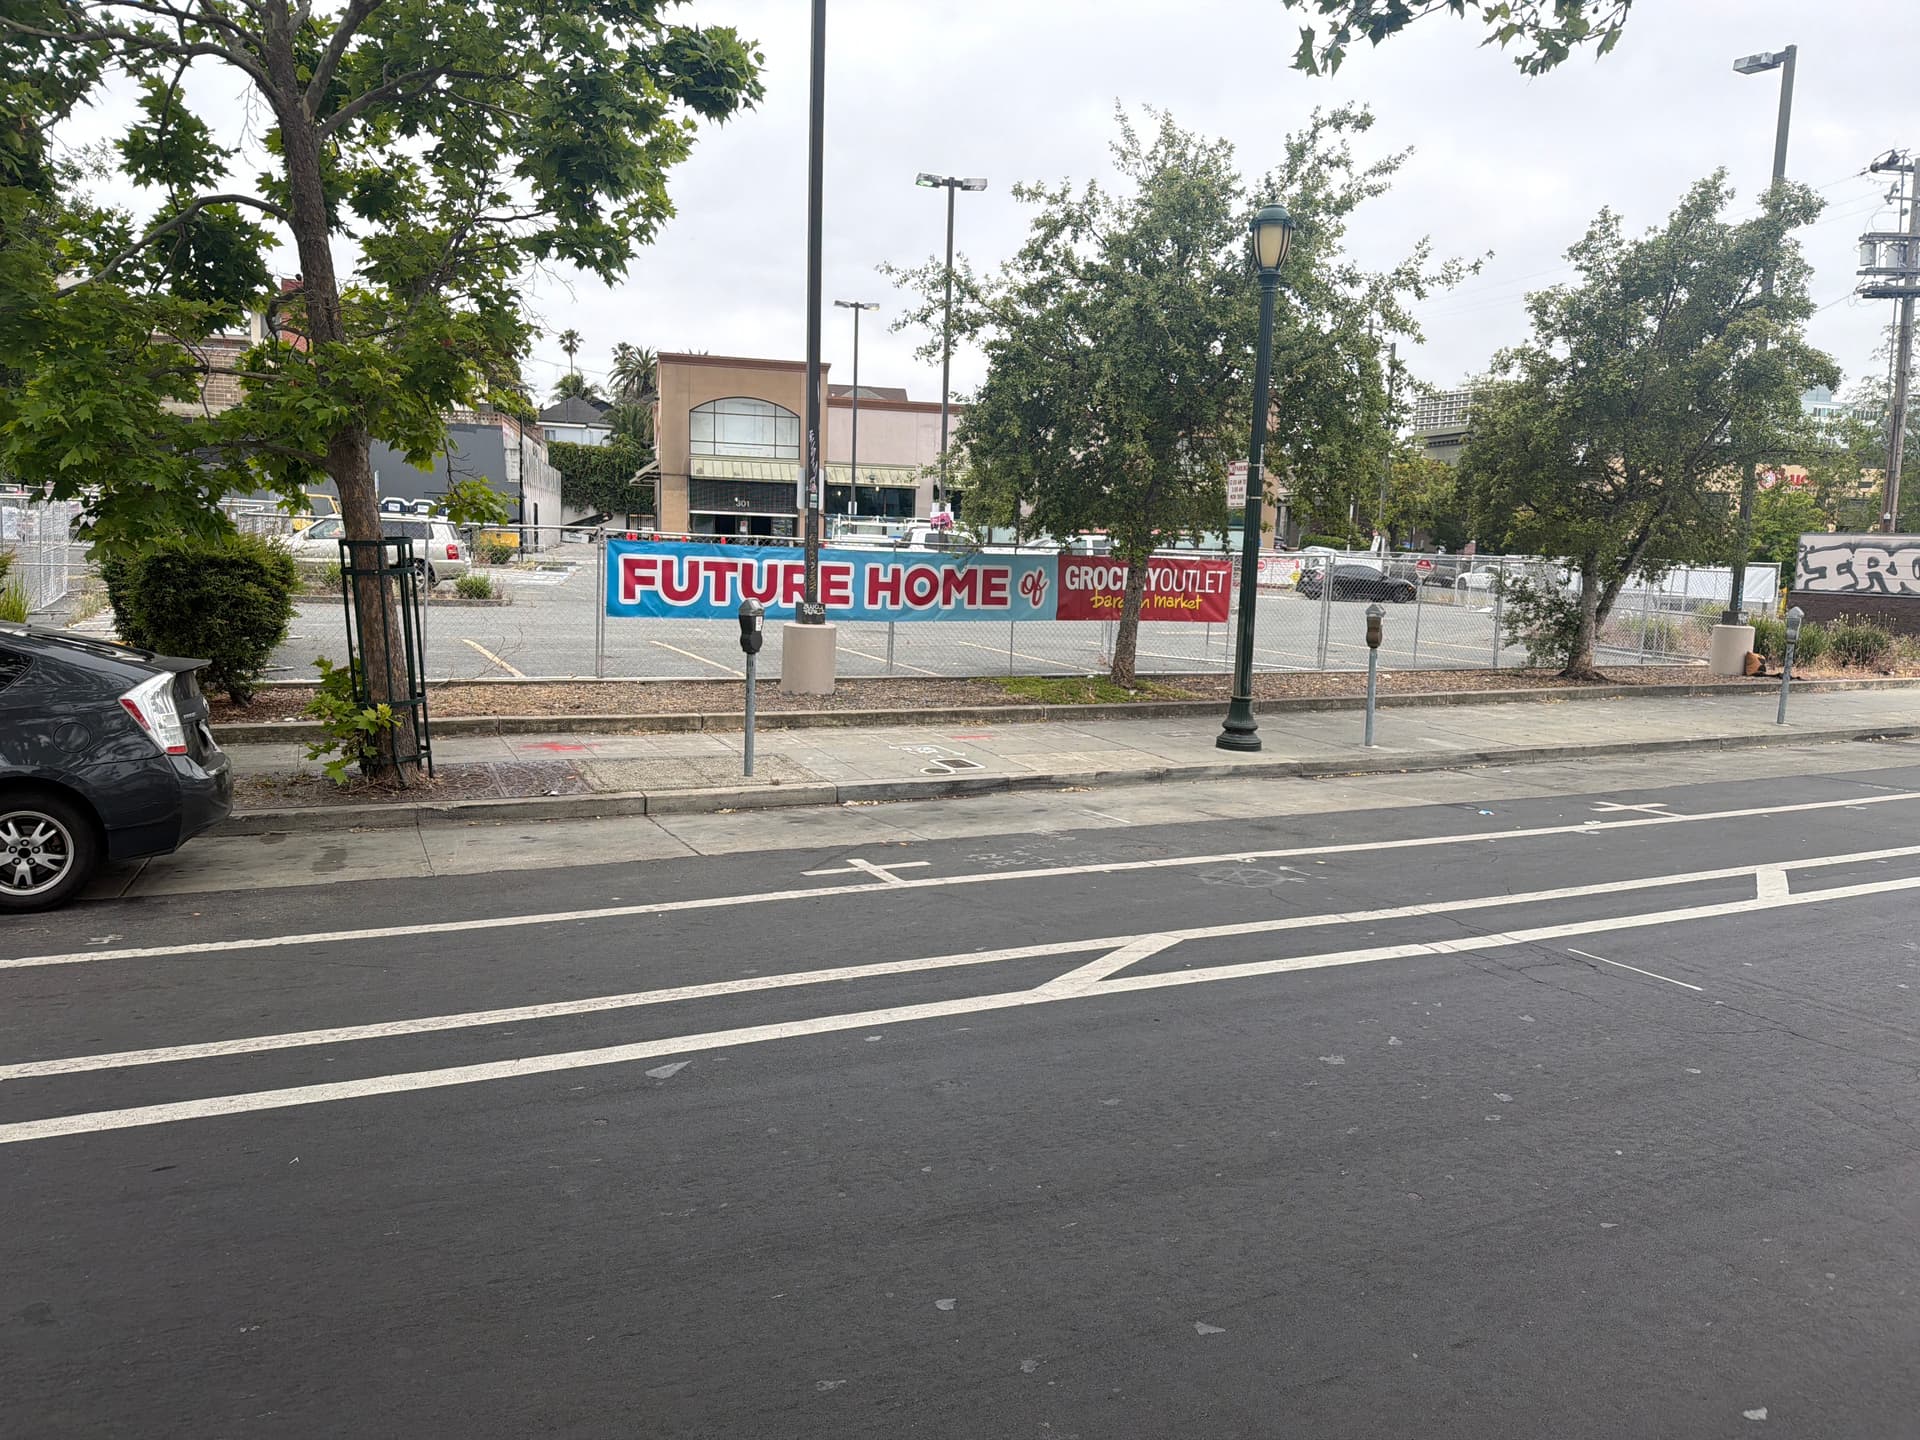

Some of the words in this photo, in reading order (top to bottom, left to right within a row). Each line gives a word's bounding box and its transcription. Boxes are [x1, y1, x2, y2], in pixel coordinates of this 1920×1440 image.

[735, 499, 750, 508] 301
[620, 555, 853, 608] FUTURE
[866, 564, 1011, 609] HOME
[1019, 568, 1048, 608] of
[1153, 594, 1203, 610] market
